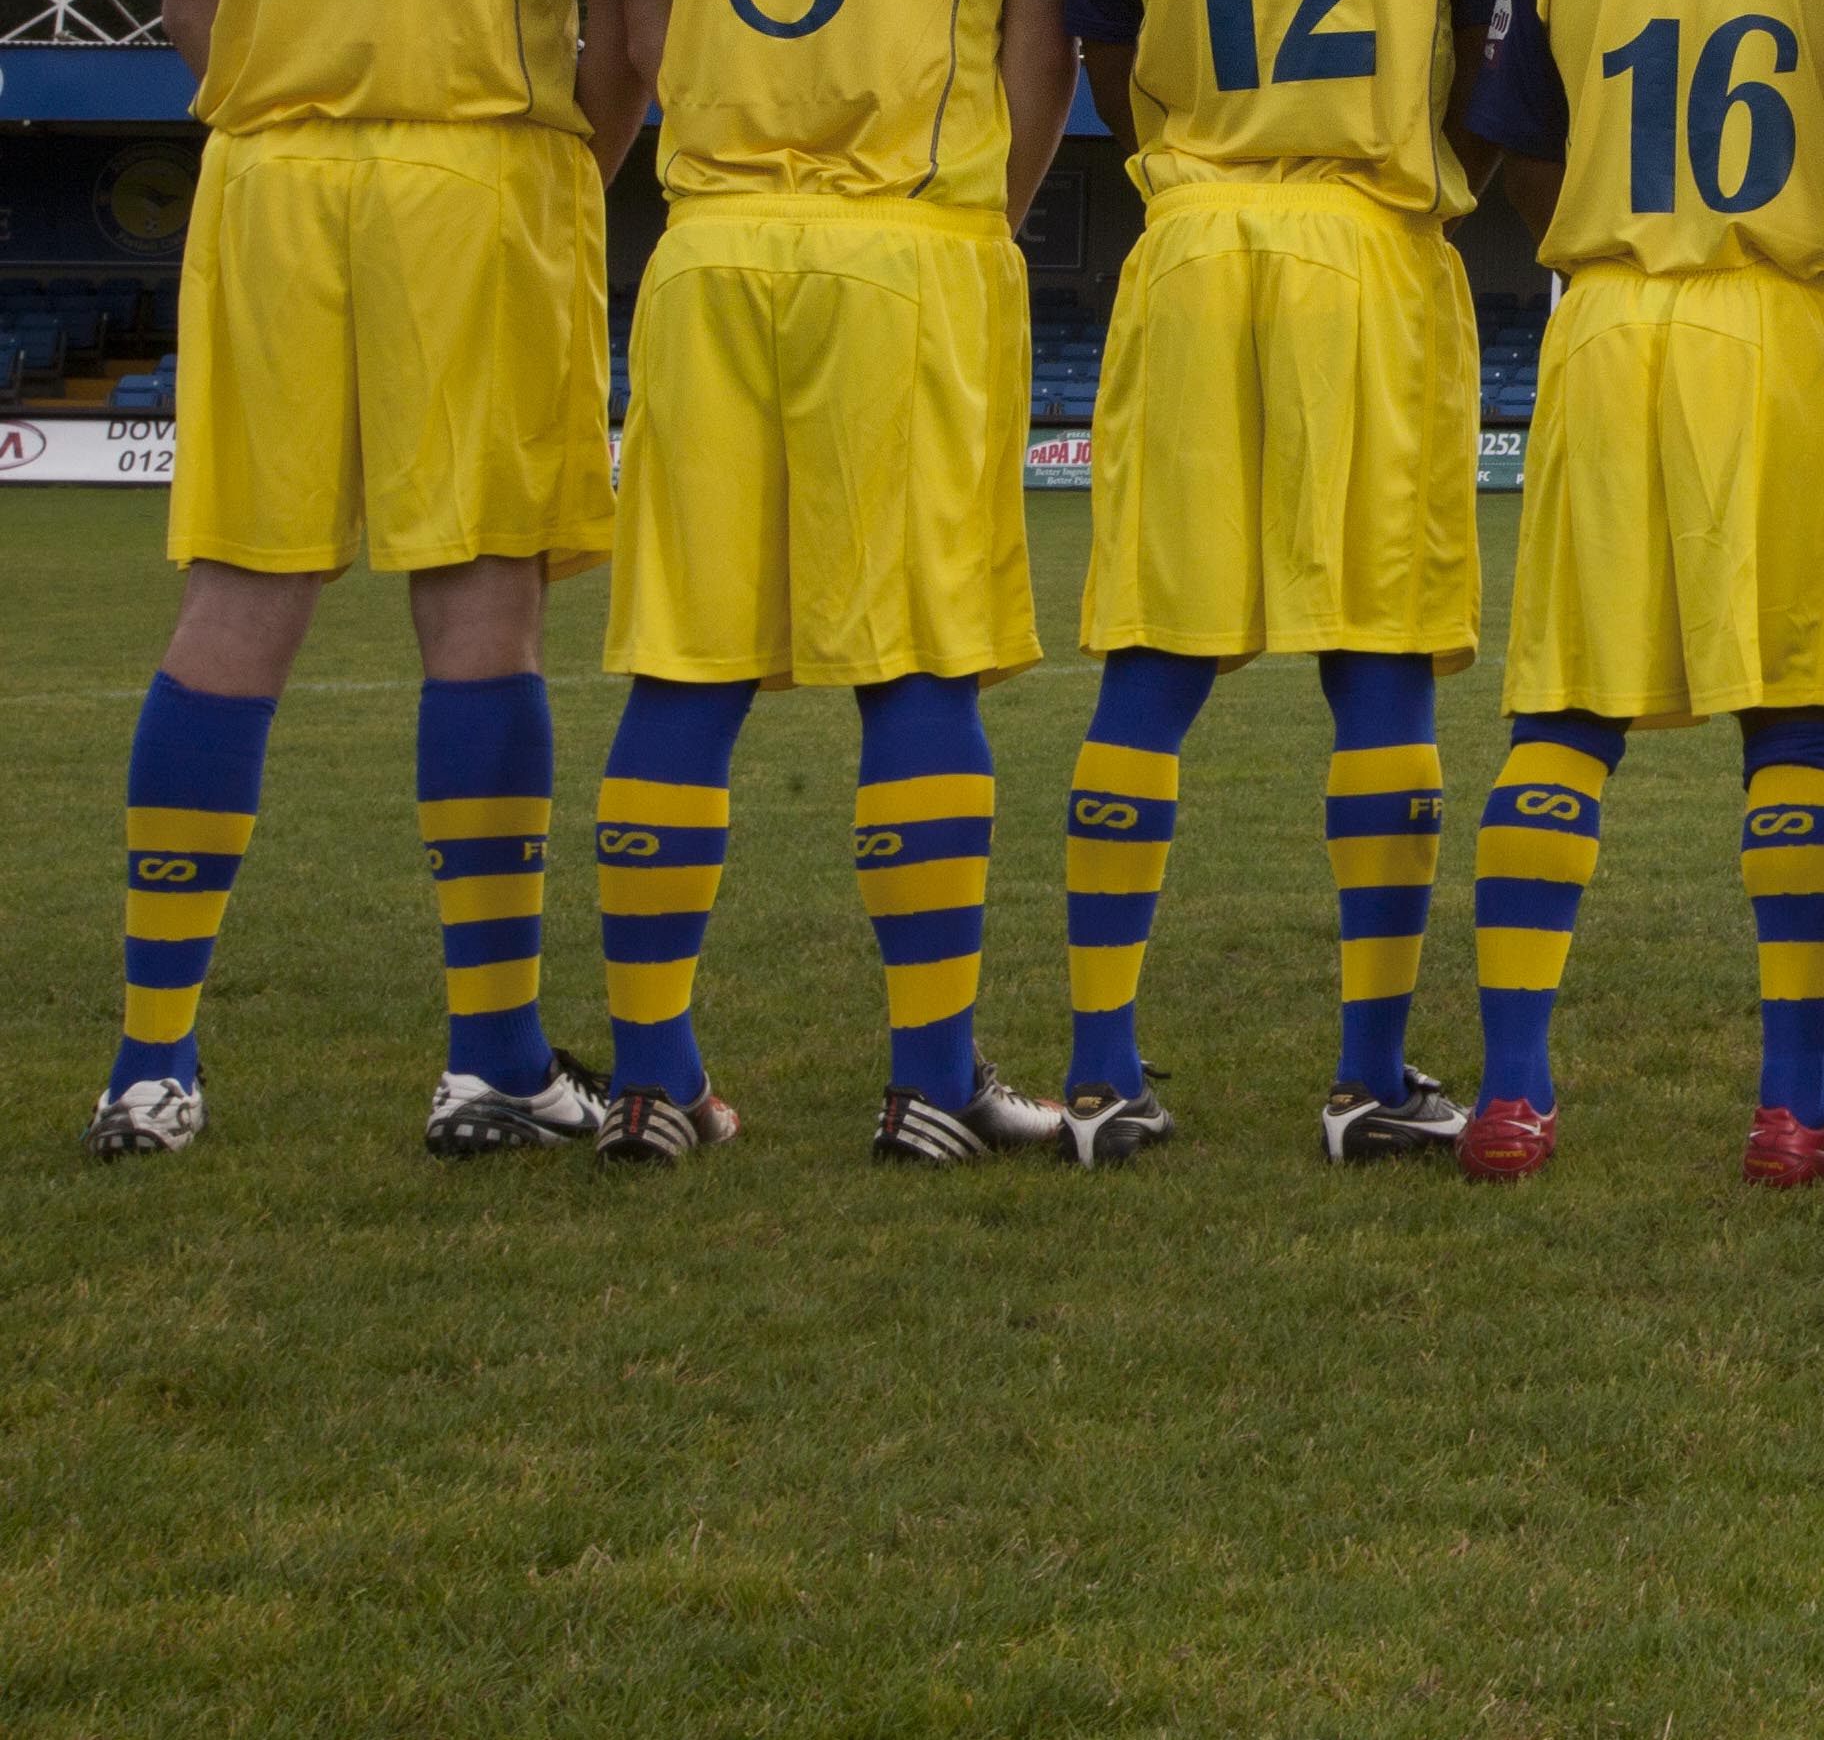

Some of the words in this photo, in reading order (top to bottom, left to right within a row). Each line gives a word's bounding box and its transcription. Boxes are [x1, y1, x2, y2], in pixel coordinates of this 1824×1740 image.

[1604, 15, 1798, 213] 16
[118, 450, 174, 472] 012
[1030, 441, 1069, 464] PAPA
